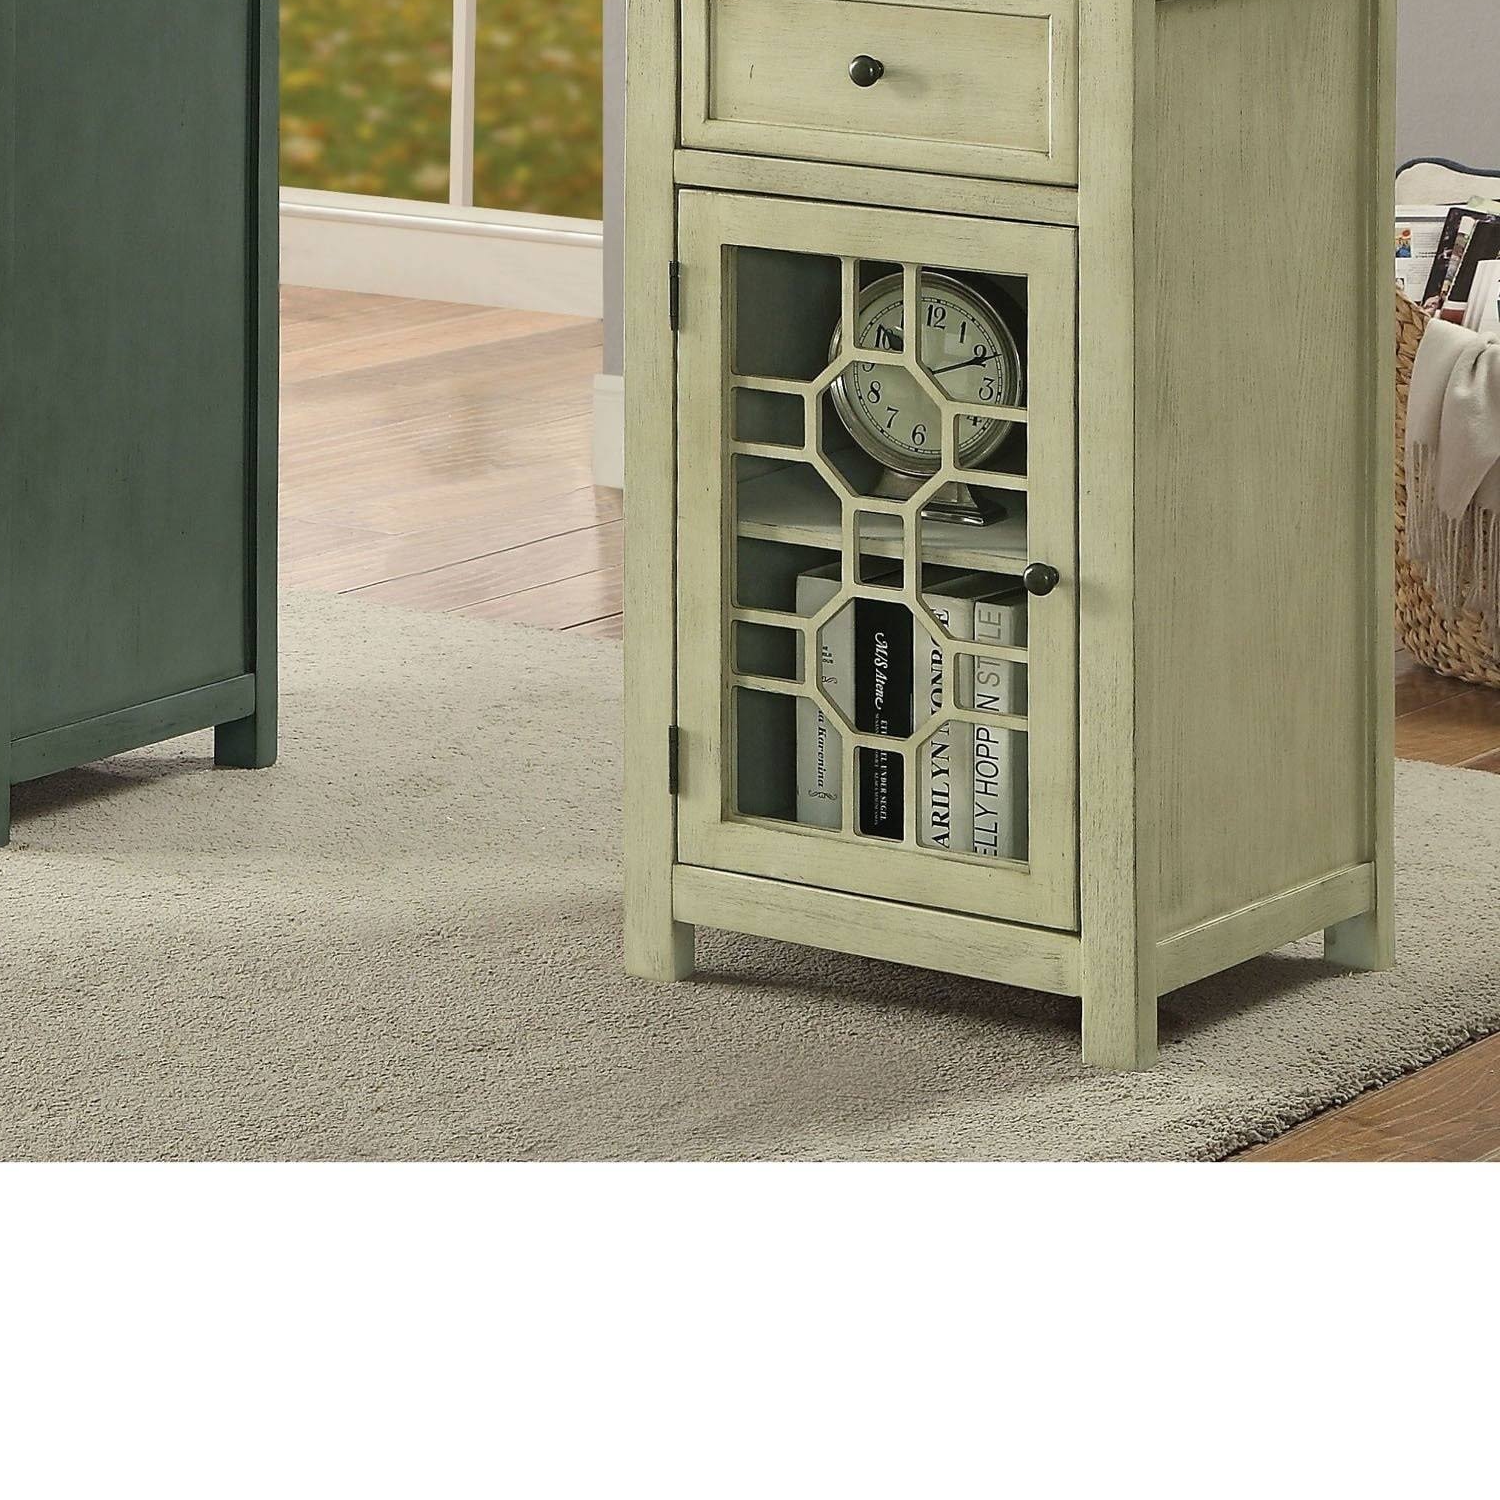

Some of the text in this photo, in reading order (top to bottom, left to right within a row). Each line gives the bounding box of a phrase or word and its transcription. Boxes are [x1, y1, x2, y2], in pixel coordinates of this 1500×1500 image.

[926, 304, 946, 330] 12
[959, 321, 967, 343] 1
[866, 380, 881, 404] 8
[978, 377, 995, 401] 3
[886, 406, 900, 429] 7
[911, 423, 927, 446] 6
[974, 609, 1001, 856] ELLY HOPPN STLE
[818, 726, 826, 788] Karenina
[930, 740, 950, 849] ARILYN
